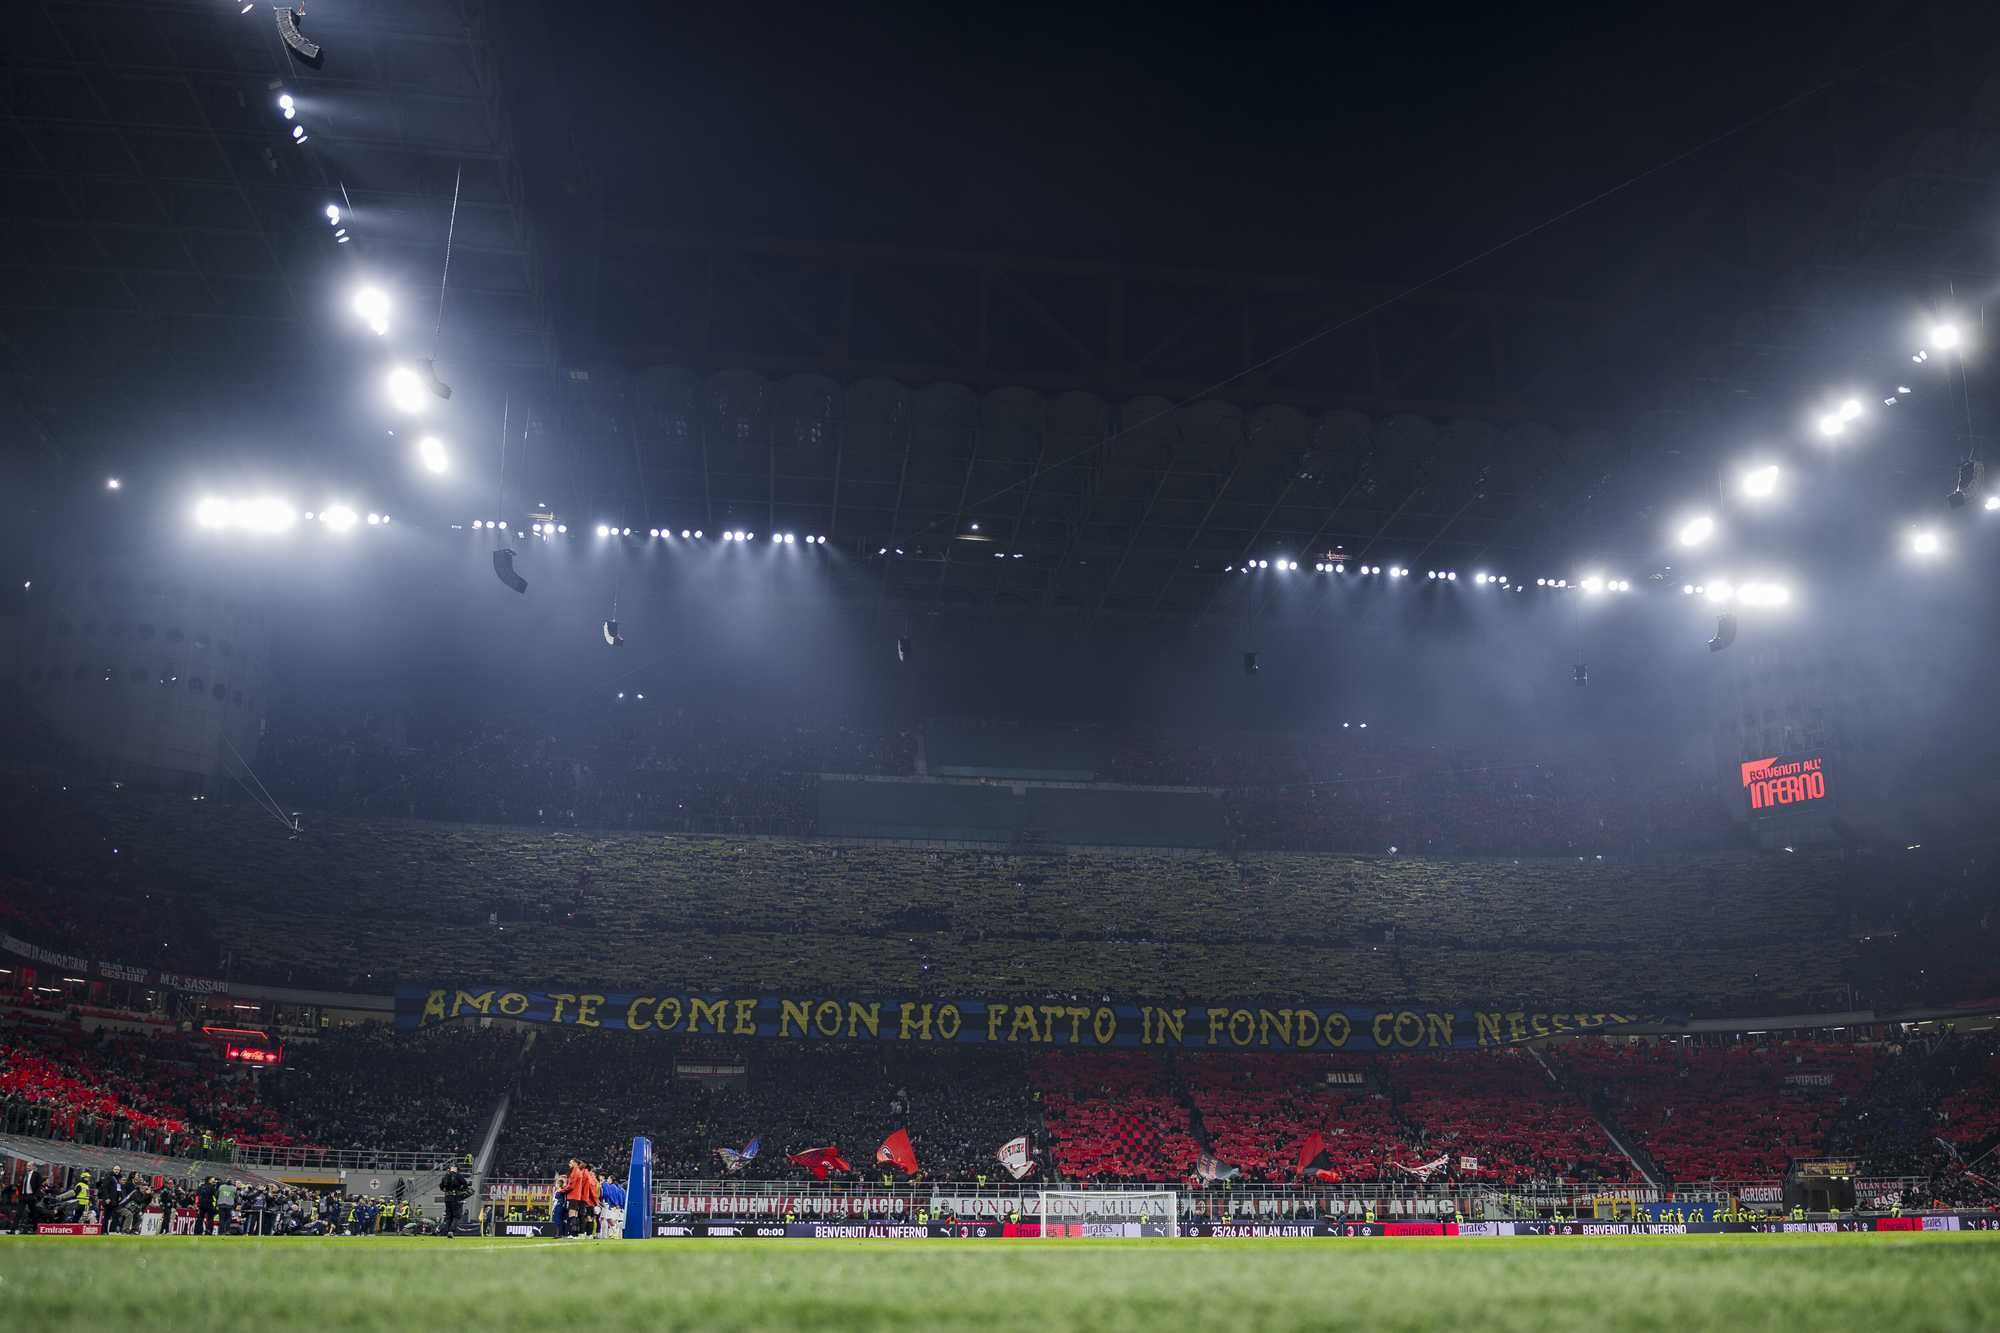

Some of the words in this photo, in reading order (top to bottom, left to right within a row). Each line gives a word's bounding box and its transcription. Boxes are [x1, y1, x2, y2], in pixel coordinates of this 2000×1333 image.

[1751, 763, 1800, 781] BENVENUTI
[1750, 772, 1824, 809] INFERNO
[419, 989, 528, 1027] AMO
[548, 993, 605, 1027] TE
[627, 997, 757, 1035] COME
[779, 1000, 880, 1037] NON
[899, 1002, 961, 1040] HO
[987, 1004, 1116, 1044] FATTO
[1141, 1007, 1186, 1044] IN
[1207, 1008, 1350, 1047] FONDO
[1372, 1012, 1455, 1047] CON
[1740, 1187, 1783, 1202] AGRIGENTO
[661, 1197, 705, 1213] MILAN
[710, 1197, 778, 1213] ACADEMY
[793, 1196, 848, 1213] SCUOLA
[853, 1196, 903, 1213] CALCIO
[1102, 1199, 1166, 1215] MILAN
[1229, 1199, 1315, 1215] FAMILY
[1330, 1199, 1376, 1215] DAY
[40, 1226, 73, 1234] Emirates
[757, 1227, 784, 1236] 00:00
[815, 1226, 867, 1238] BENVENUTI
[868, 1226, 928, 1238] ALL'INFERNO
[1212, 1225, 1236, 1237] 25/26
[1238, 1225, 1251, 1237] AC
[1252, 1225, 1281, 1237] MILAN
[1282, 1225, 1299, 1237] 4TH
[1300, 1225, 1314, 1237] KIT
[1583, 1224, 1631, 1235] BENVENUTI
[1632, 1224, 1687, 1235] ALL'INFERNO
[1783, 1223, 1807, 1232] BENVENUTI
